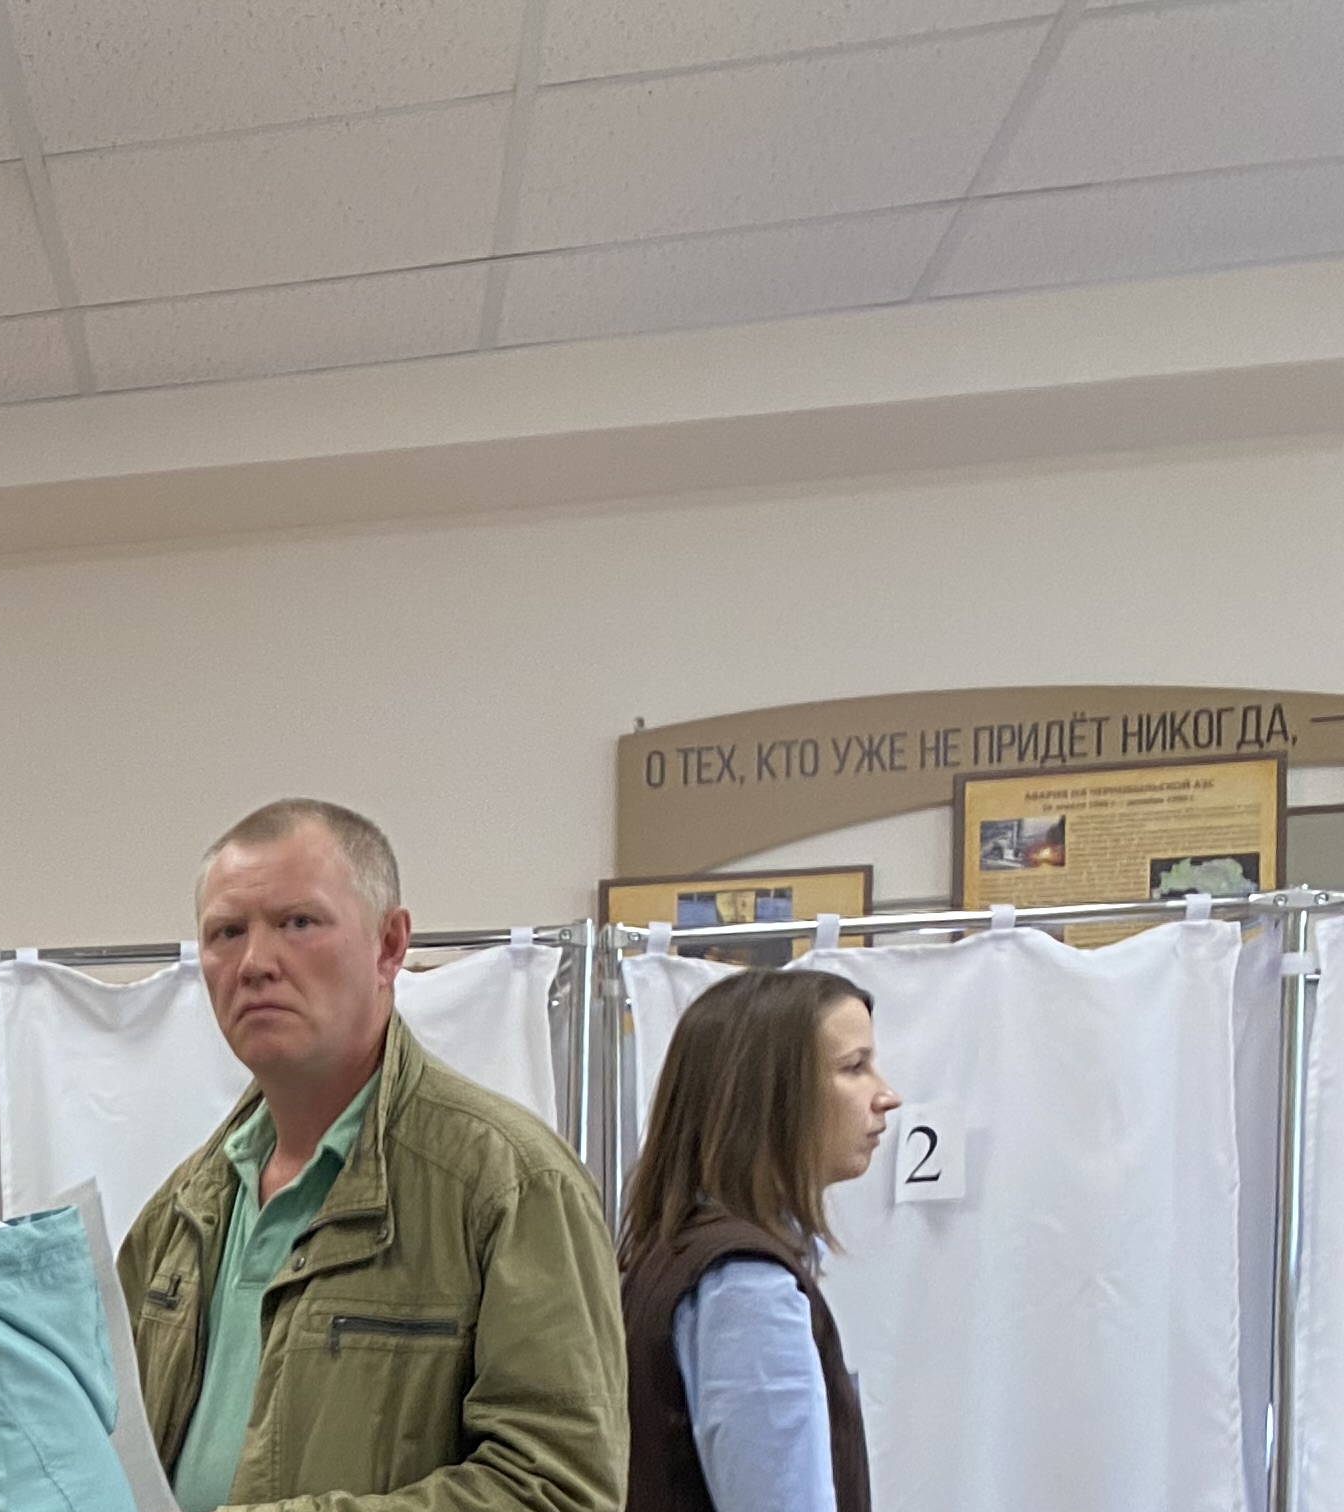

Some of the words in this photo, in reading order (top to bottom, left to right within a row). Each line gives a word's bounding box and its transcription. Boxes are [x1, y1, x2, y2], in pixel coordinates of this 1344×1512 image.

[645, 750, 666, 788] О
[676, 744, 745, 786] ТЕХ,
[757, 738, 820, 781] КТО
[832, 732, 907, 775] УЖЕ
[919, 728, 961, 770] НЕ
[973, 711, 1110, 767] ПРИДЁТ
[1121, 703, 1298, 755] НИКОГДА,
[905, 1125, 941, 1184] 2
